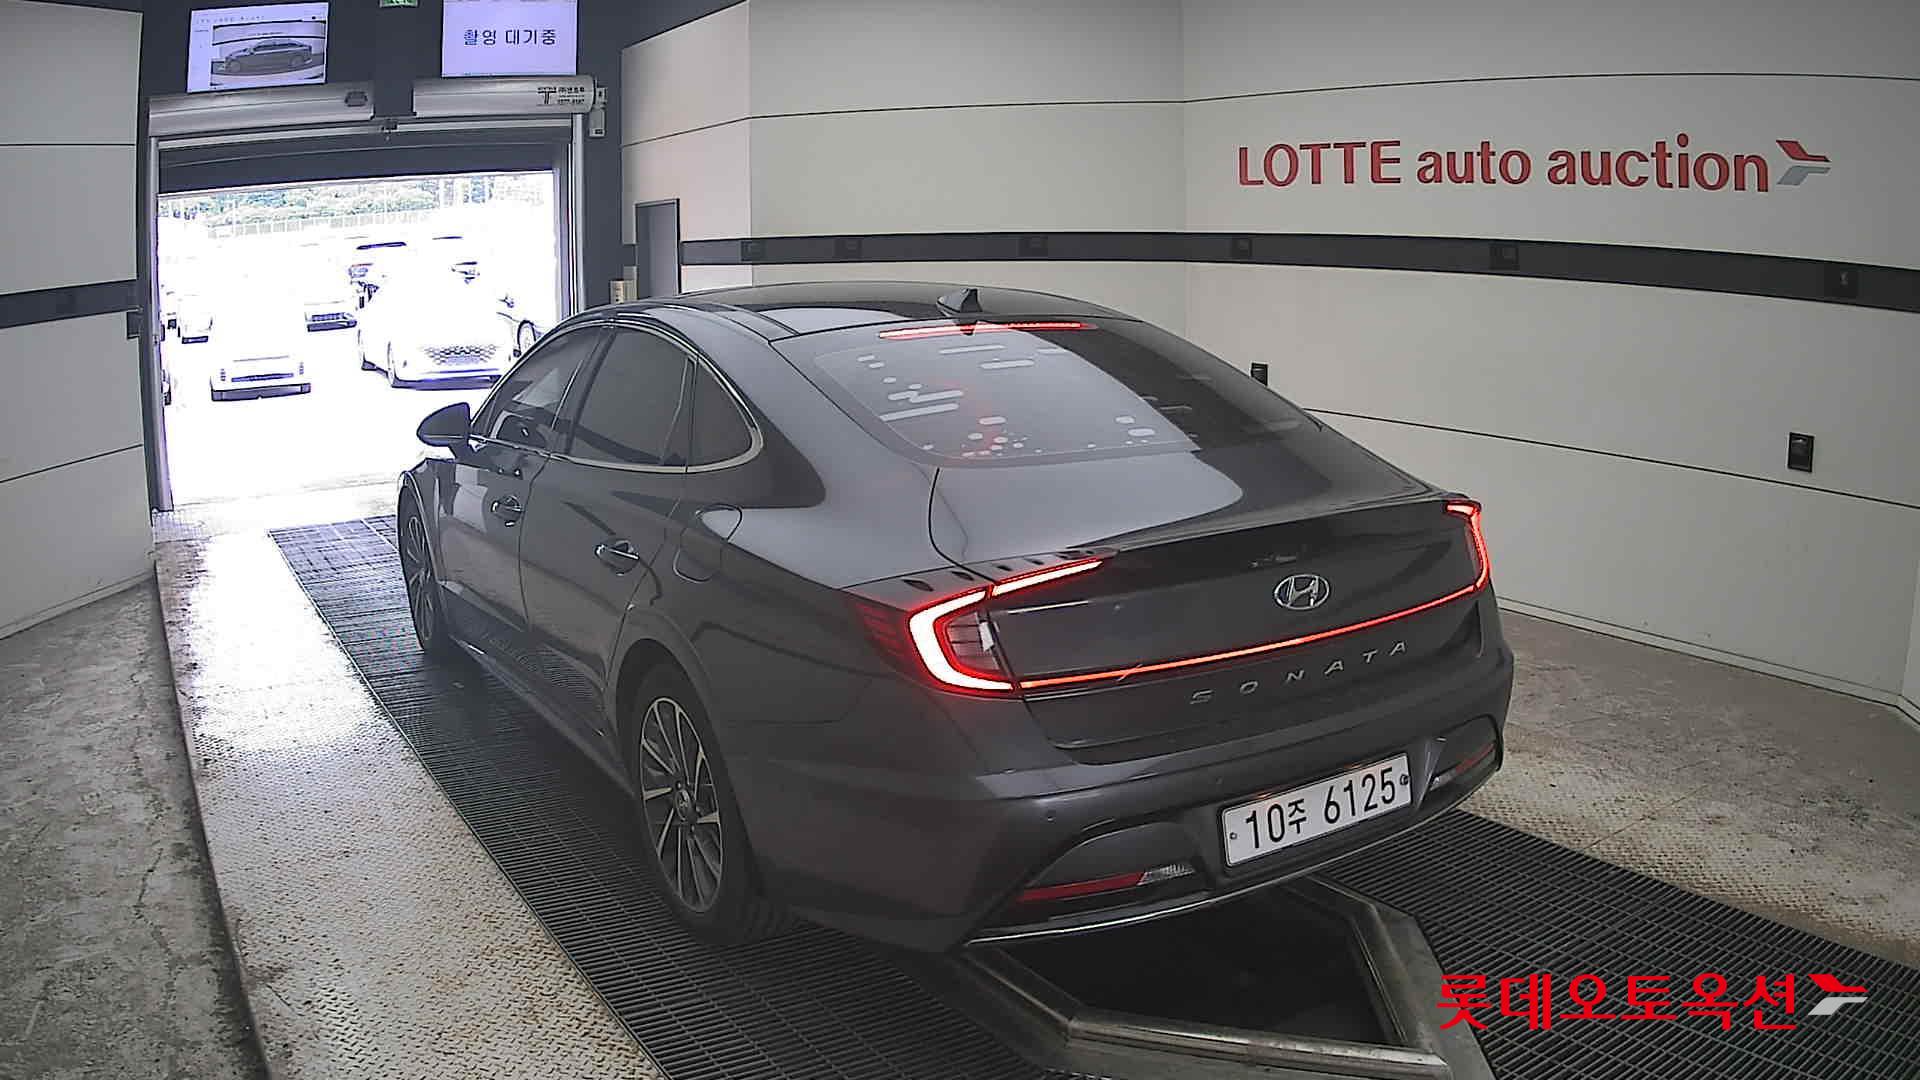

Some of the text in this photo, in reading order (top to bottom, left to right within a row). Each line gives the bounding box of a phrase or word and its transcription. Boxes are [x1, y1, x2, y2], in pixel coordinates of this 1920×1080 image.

[505, 29, 556, 46] 대기중
[1239, 133, 1769, 192] LOTTE auto auction
[1190, 641, 1407, 705] SONATA
[1245, 767, 1396, 849] 10주 6125
